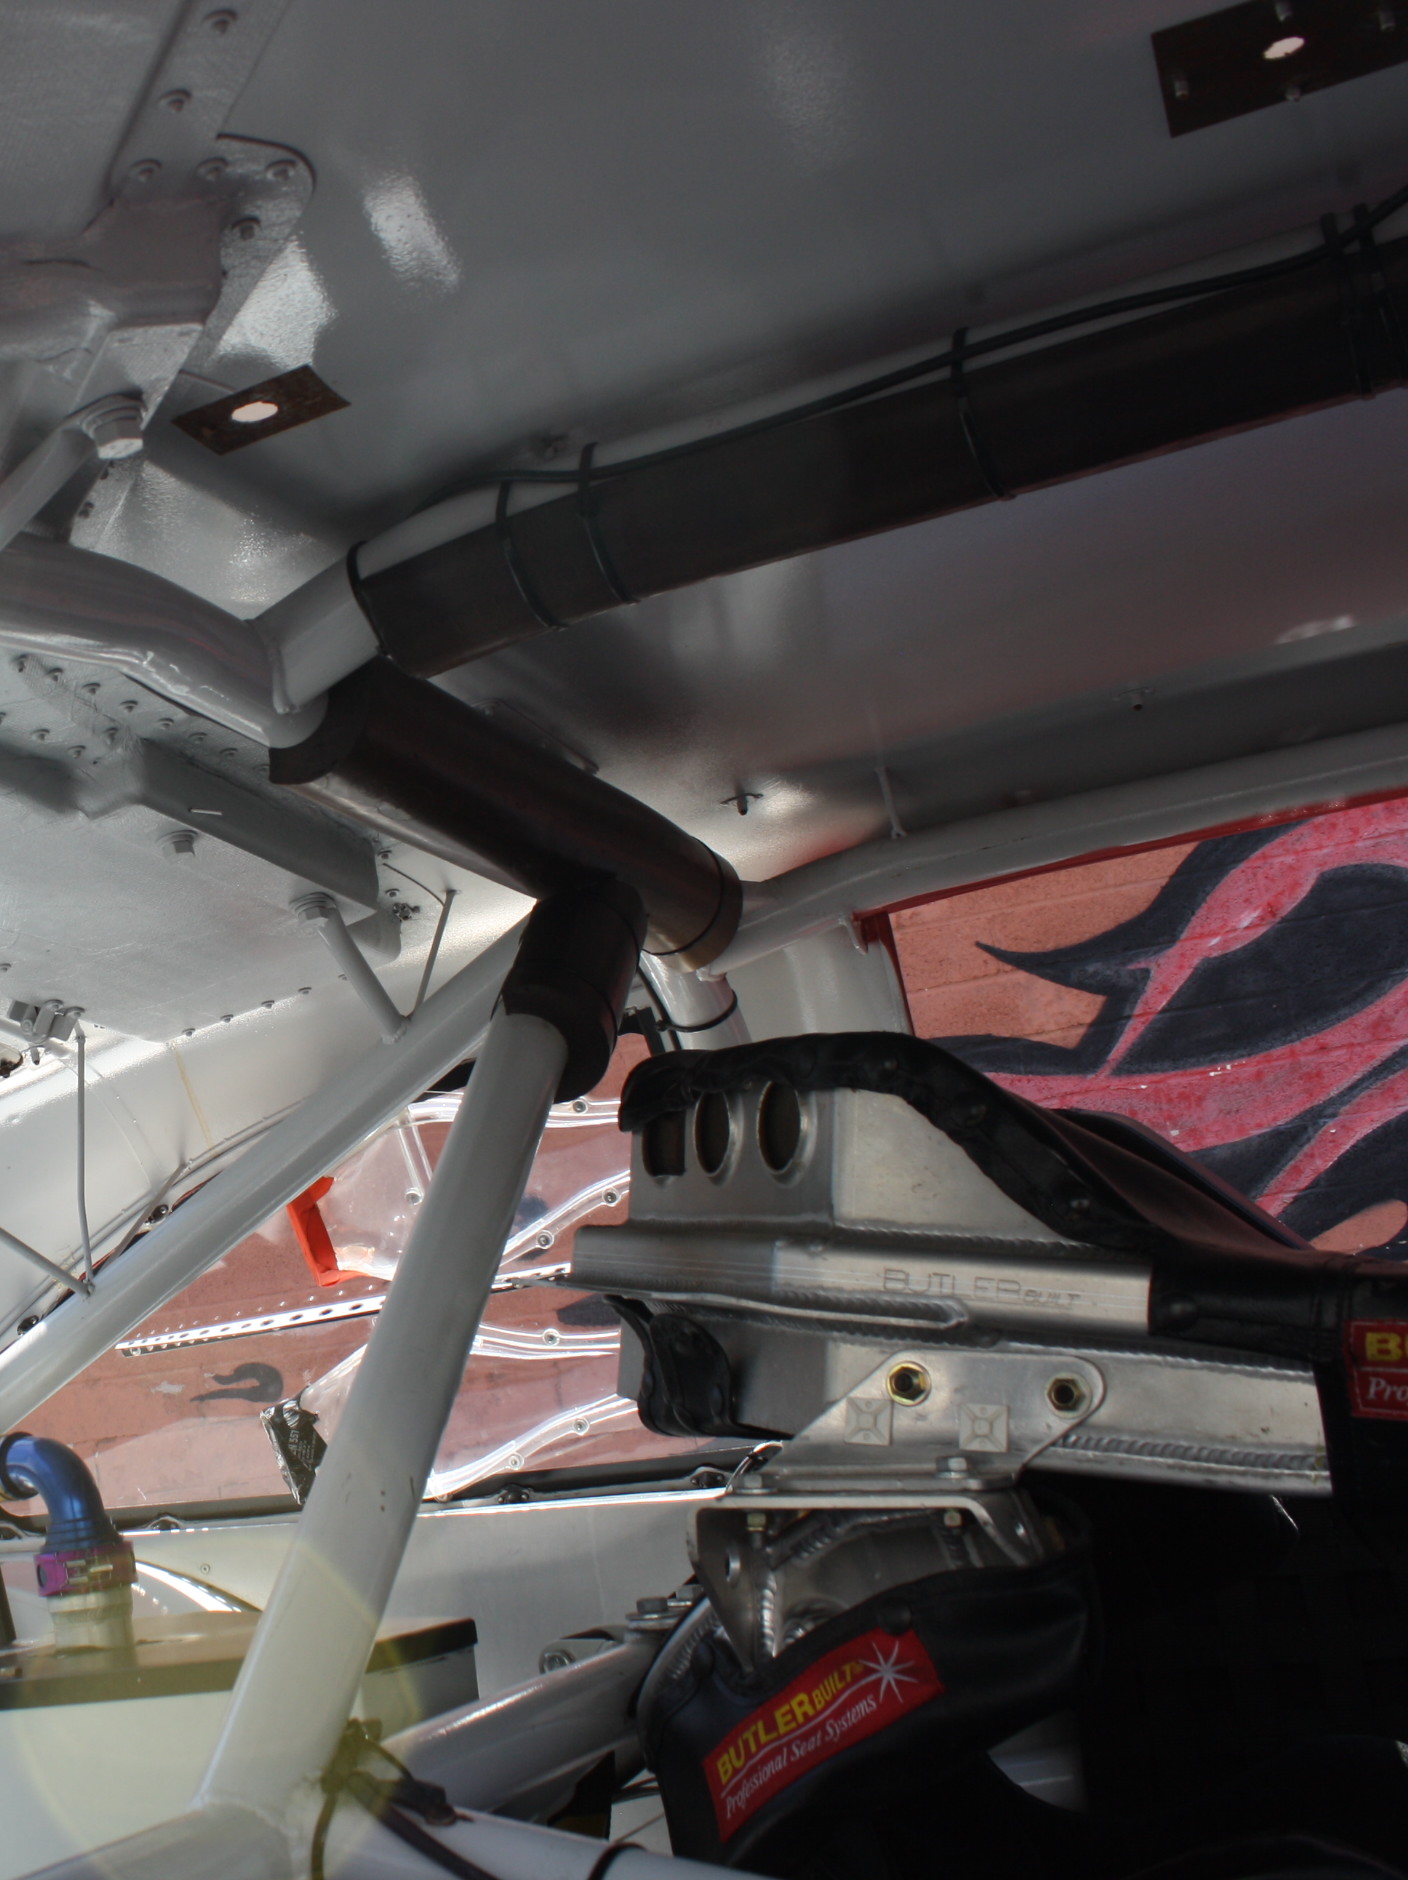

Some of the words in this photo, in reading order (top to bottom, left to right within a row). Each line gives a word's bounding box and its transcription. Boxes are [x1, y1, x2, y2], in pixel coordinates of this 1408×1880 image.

[1365, 1331, 1408, 1363] B
[1366, 1375, 1408, 1407] Pro
[724, 1748, 788, 1819] Professional
[790, 1731, 822, 1762] Seat
[825, 1694, 878, 1742] Systems
